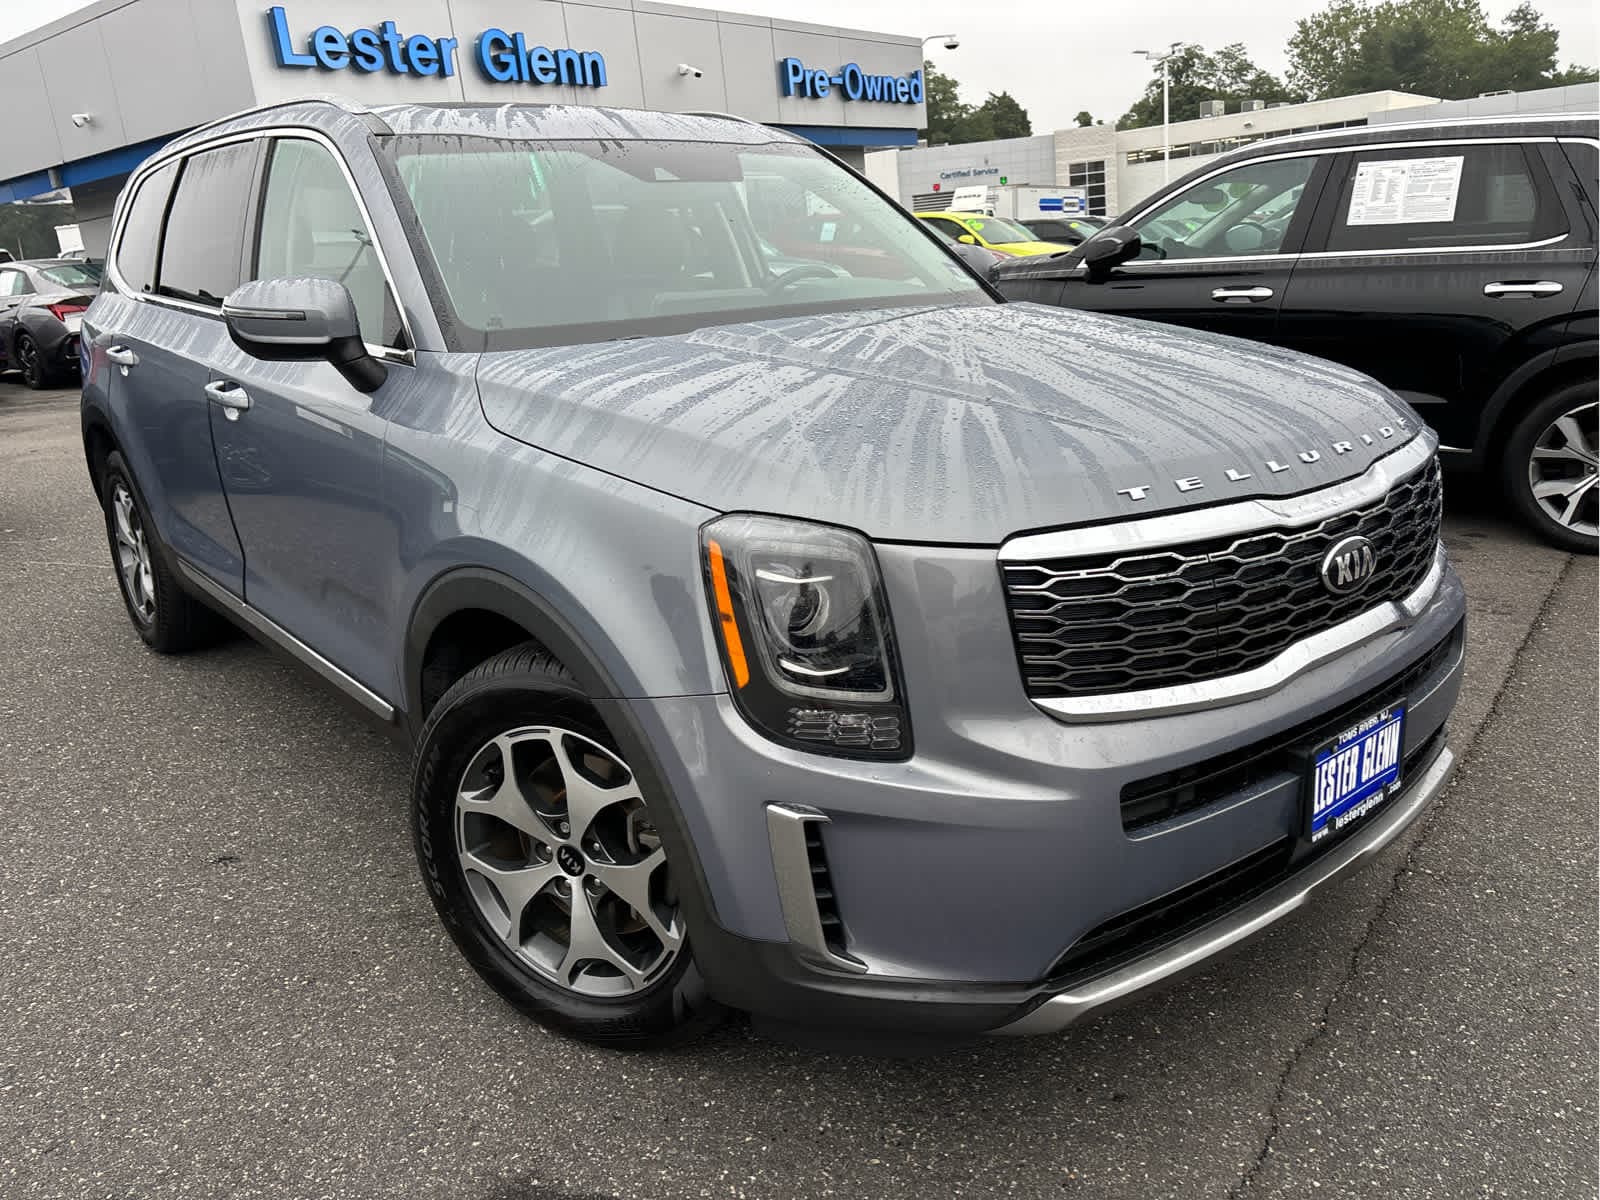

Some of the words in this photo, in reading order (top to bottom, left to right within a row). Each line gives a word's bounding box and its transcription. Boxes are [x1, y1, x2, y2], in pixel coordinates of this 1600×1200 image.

[265, 6, 457, 78] Lester
[475, 28, 608, 88] Glenn
[781, 57, 923, 105] Pre-Owned
[940, 169, 971, 180] Certified
[973, 167, 999, 177] Service
[1117, 417, 1407, 501] TELLURIDE
[1335, 545, 1375, 586] KIA
[1313, 744, 1360, 815] LESTER
[1361, 720, 1400, 783] GLENN
